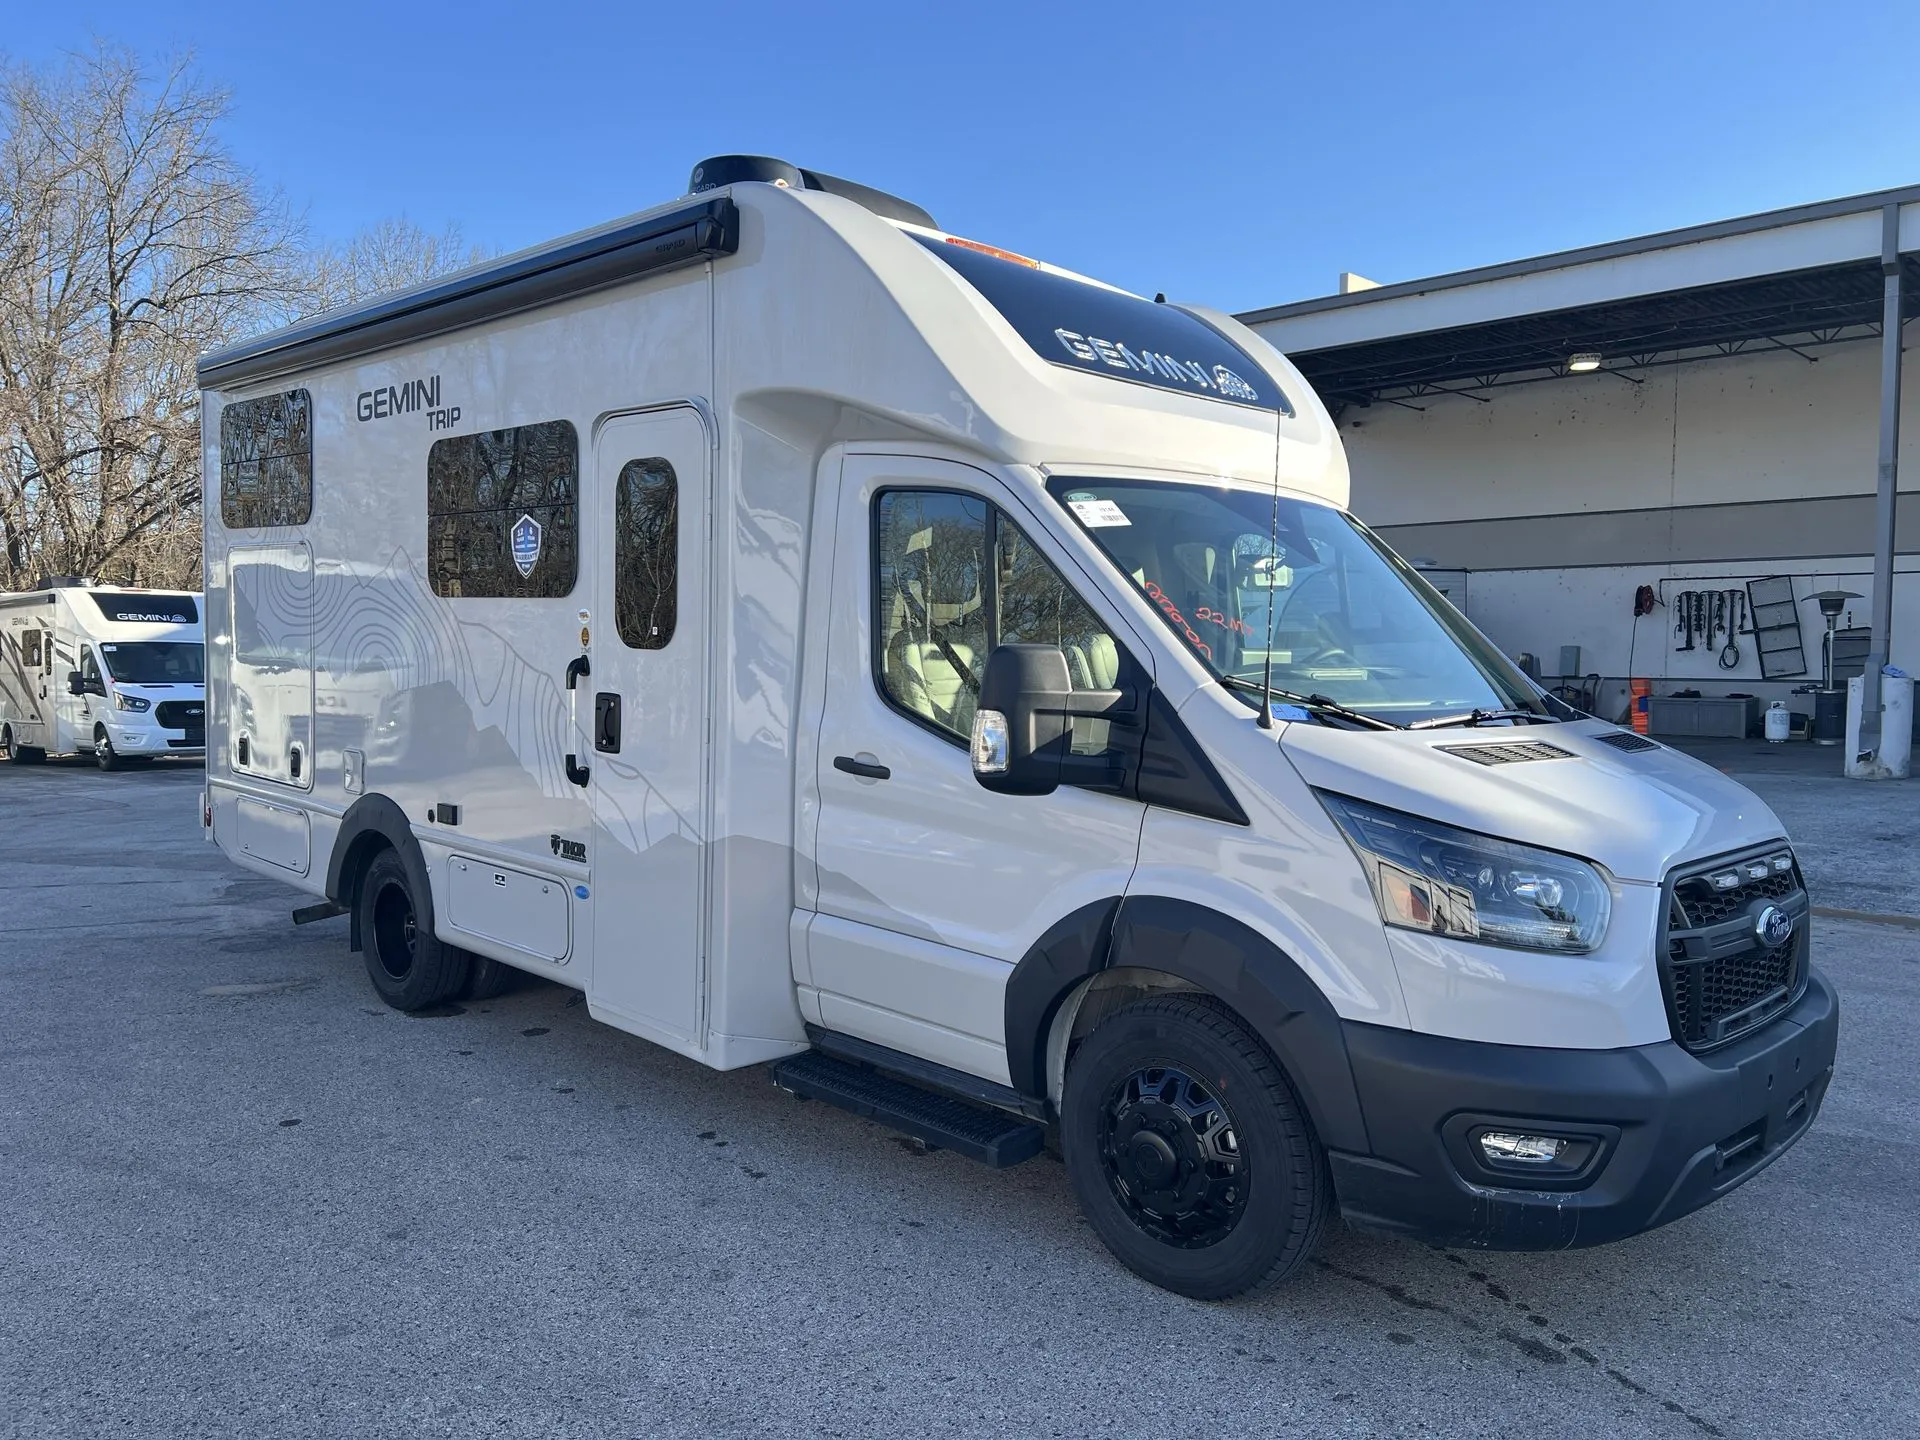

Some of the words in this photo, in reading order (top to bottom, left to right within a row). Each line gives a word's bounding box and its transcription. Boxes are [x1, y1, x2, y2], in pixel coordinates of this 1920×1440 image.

[1054, 327, 1217, 390] GEMINI
[357, 375, 440, 422] GEMINI
[426, 406, 461, 432] TRIP
[116, 613, 171, 622] GEMINI
[561, 839, 587, 858] THOR
